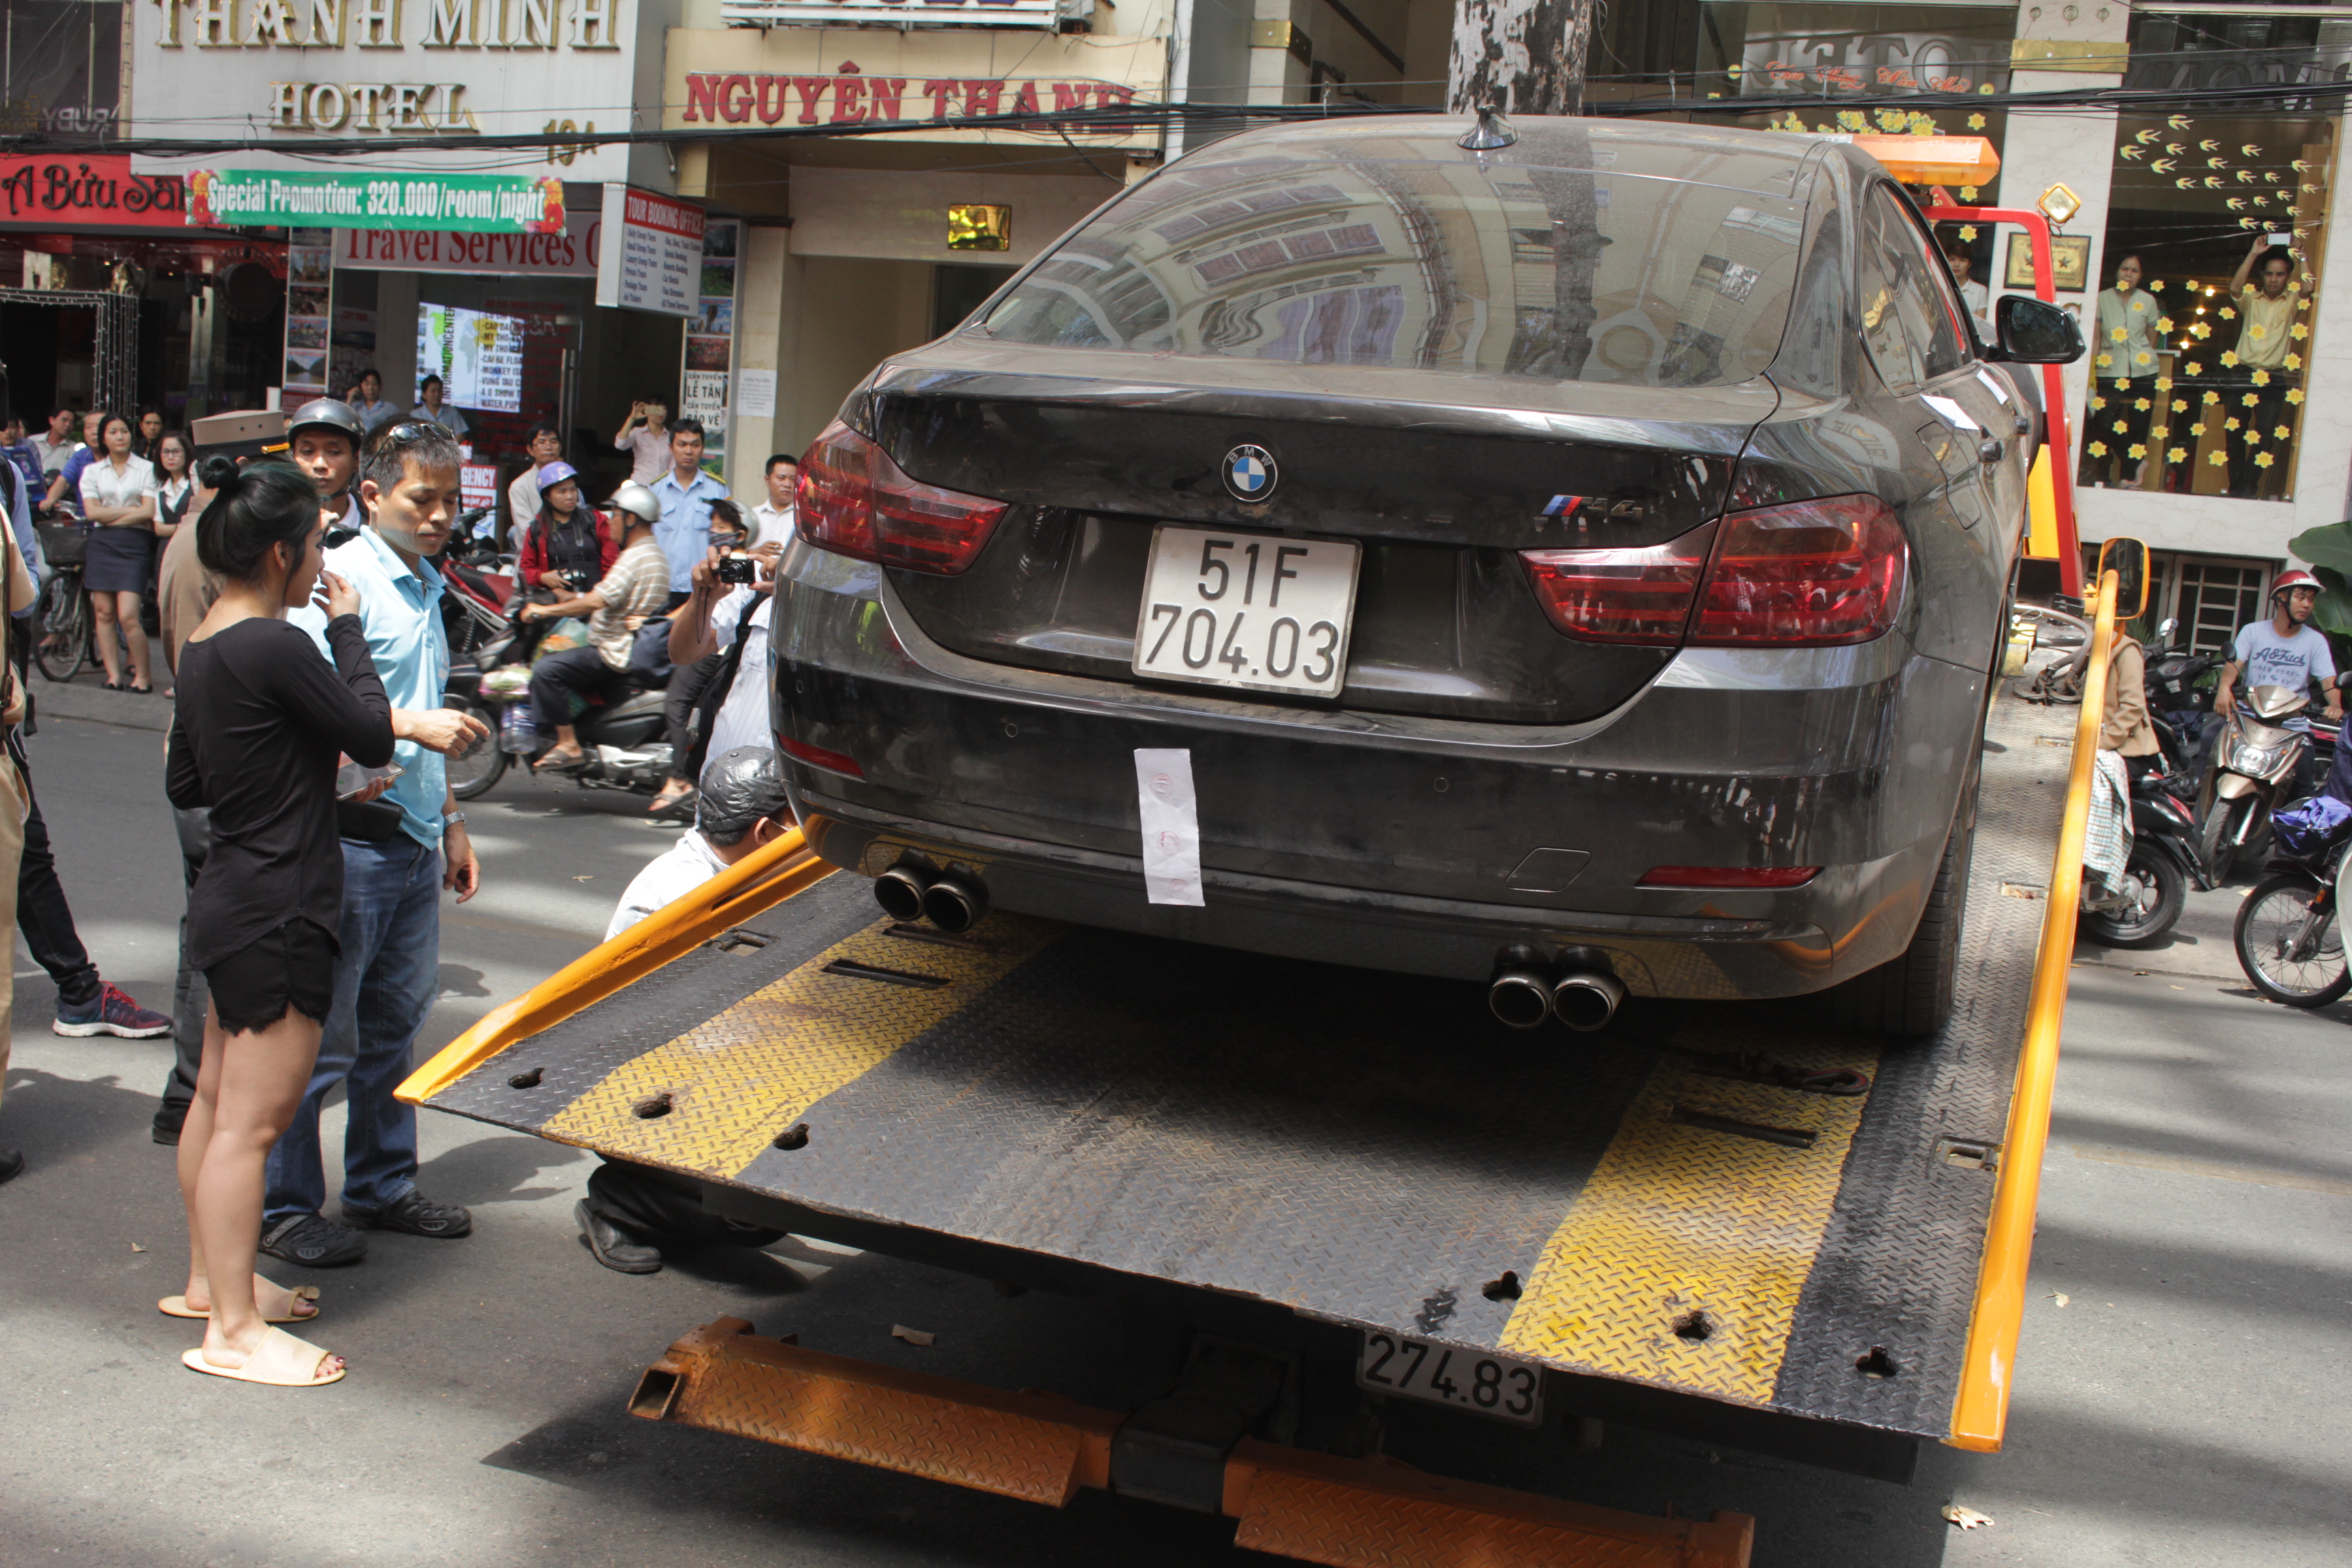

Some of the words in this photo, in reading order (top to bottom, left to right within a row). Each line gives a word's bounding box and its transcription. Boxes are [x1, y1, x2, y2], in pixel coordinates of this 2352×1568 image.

[151, 0, 404, 48] THANH
[421, 0, 620, 50] MINH
[269, 82, 480, 133] HOTEL
[683, 59, 906, 124] NGUYÊN
[923, 78, 1136, 135] THANH
[1, 165, 35, 215] A
[207, 178, 266, 217] Special
[270, 178, 361, 214] Promotion:
[367, 181, 547, 226] 320.000/room/night
[628, 196, 647, 222] TOUR
[648, 201, 679, 229] BOOKING
[679, 209, 703, 235] OFFICE
[347, 228, 440, 262] Travel
[448, 230, 576, 267] Services
[702, 383, 721, 399] TÂN
[1227, 446, 1273, 467] BMW
[1198, 539, 1308, 608] 51F
[1145, 603, 1339, 683] 704.03
[1365, 1334, 1537, 1416] 274.83
